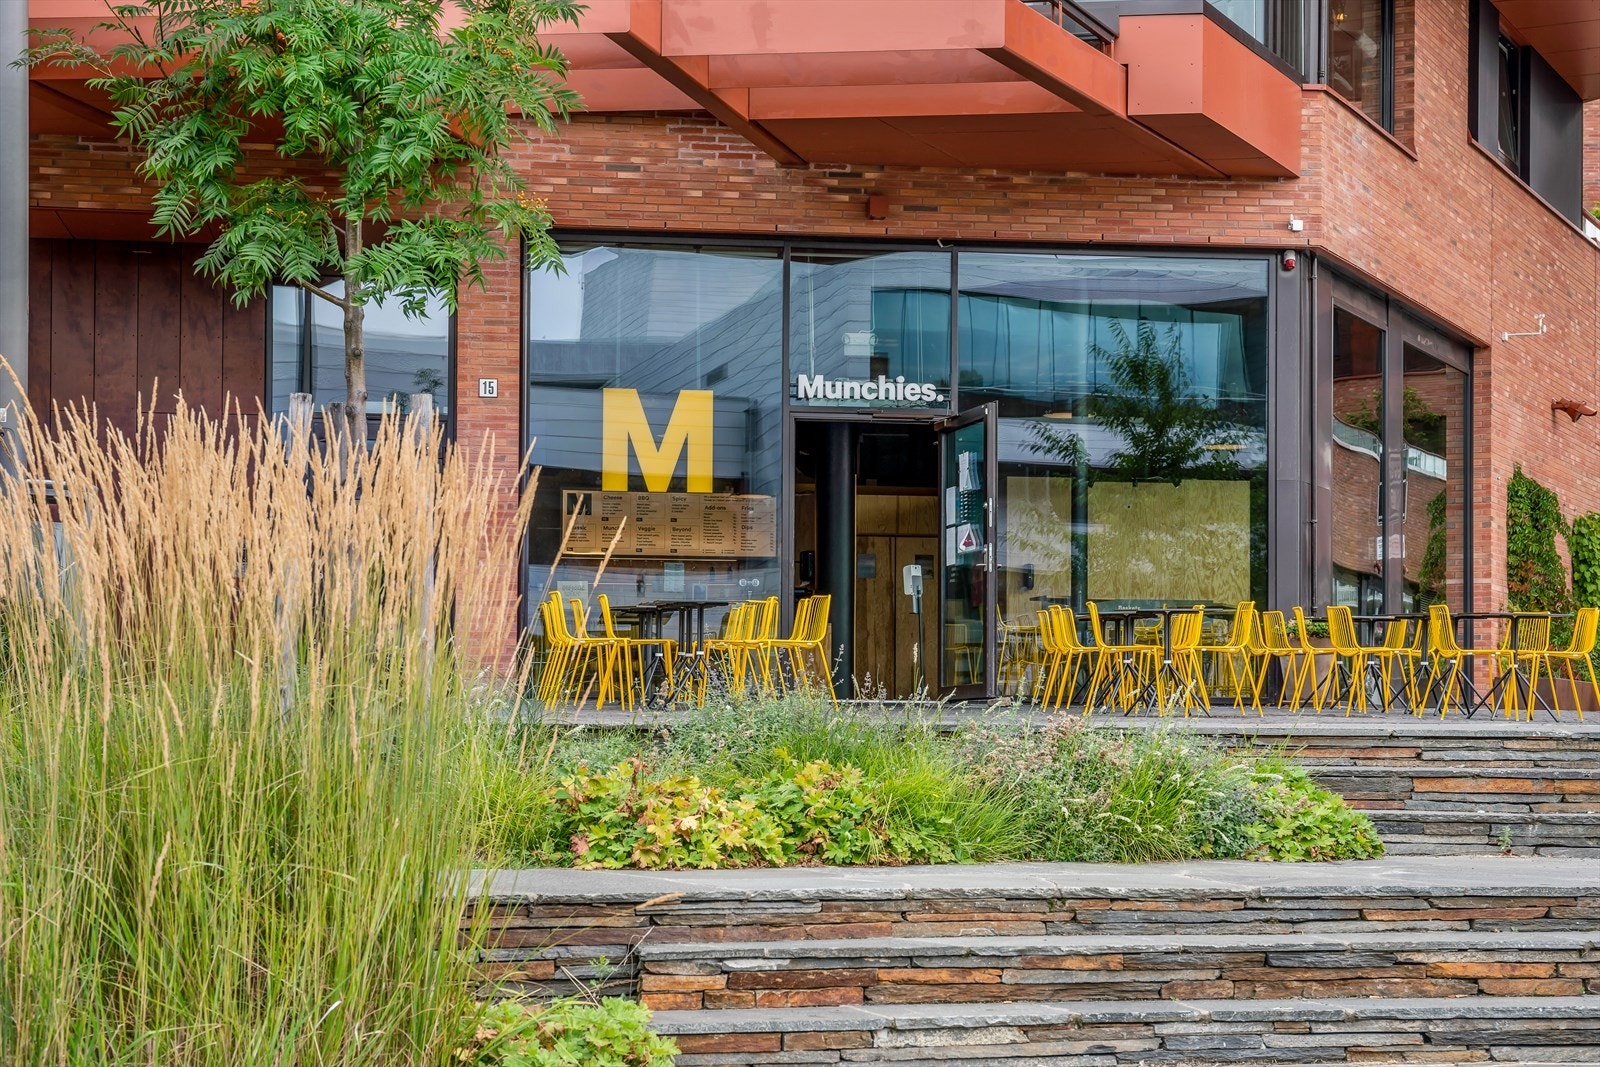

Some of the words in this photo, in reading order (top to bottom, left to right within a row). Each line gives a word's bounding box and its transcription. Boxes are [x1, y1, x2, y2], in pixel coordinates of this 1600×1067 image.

[482, 381, 494, 394] 15
[798, 374, 944, 402] Munchies.
[602, 388, 714, 493] M
